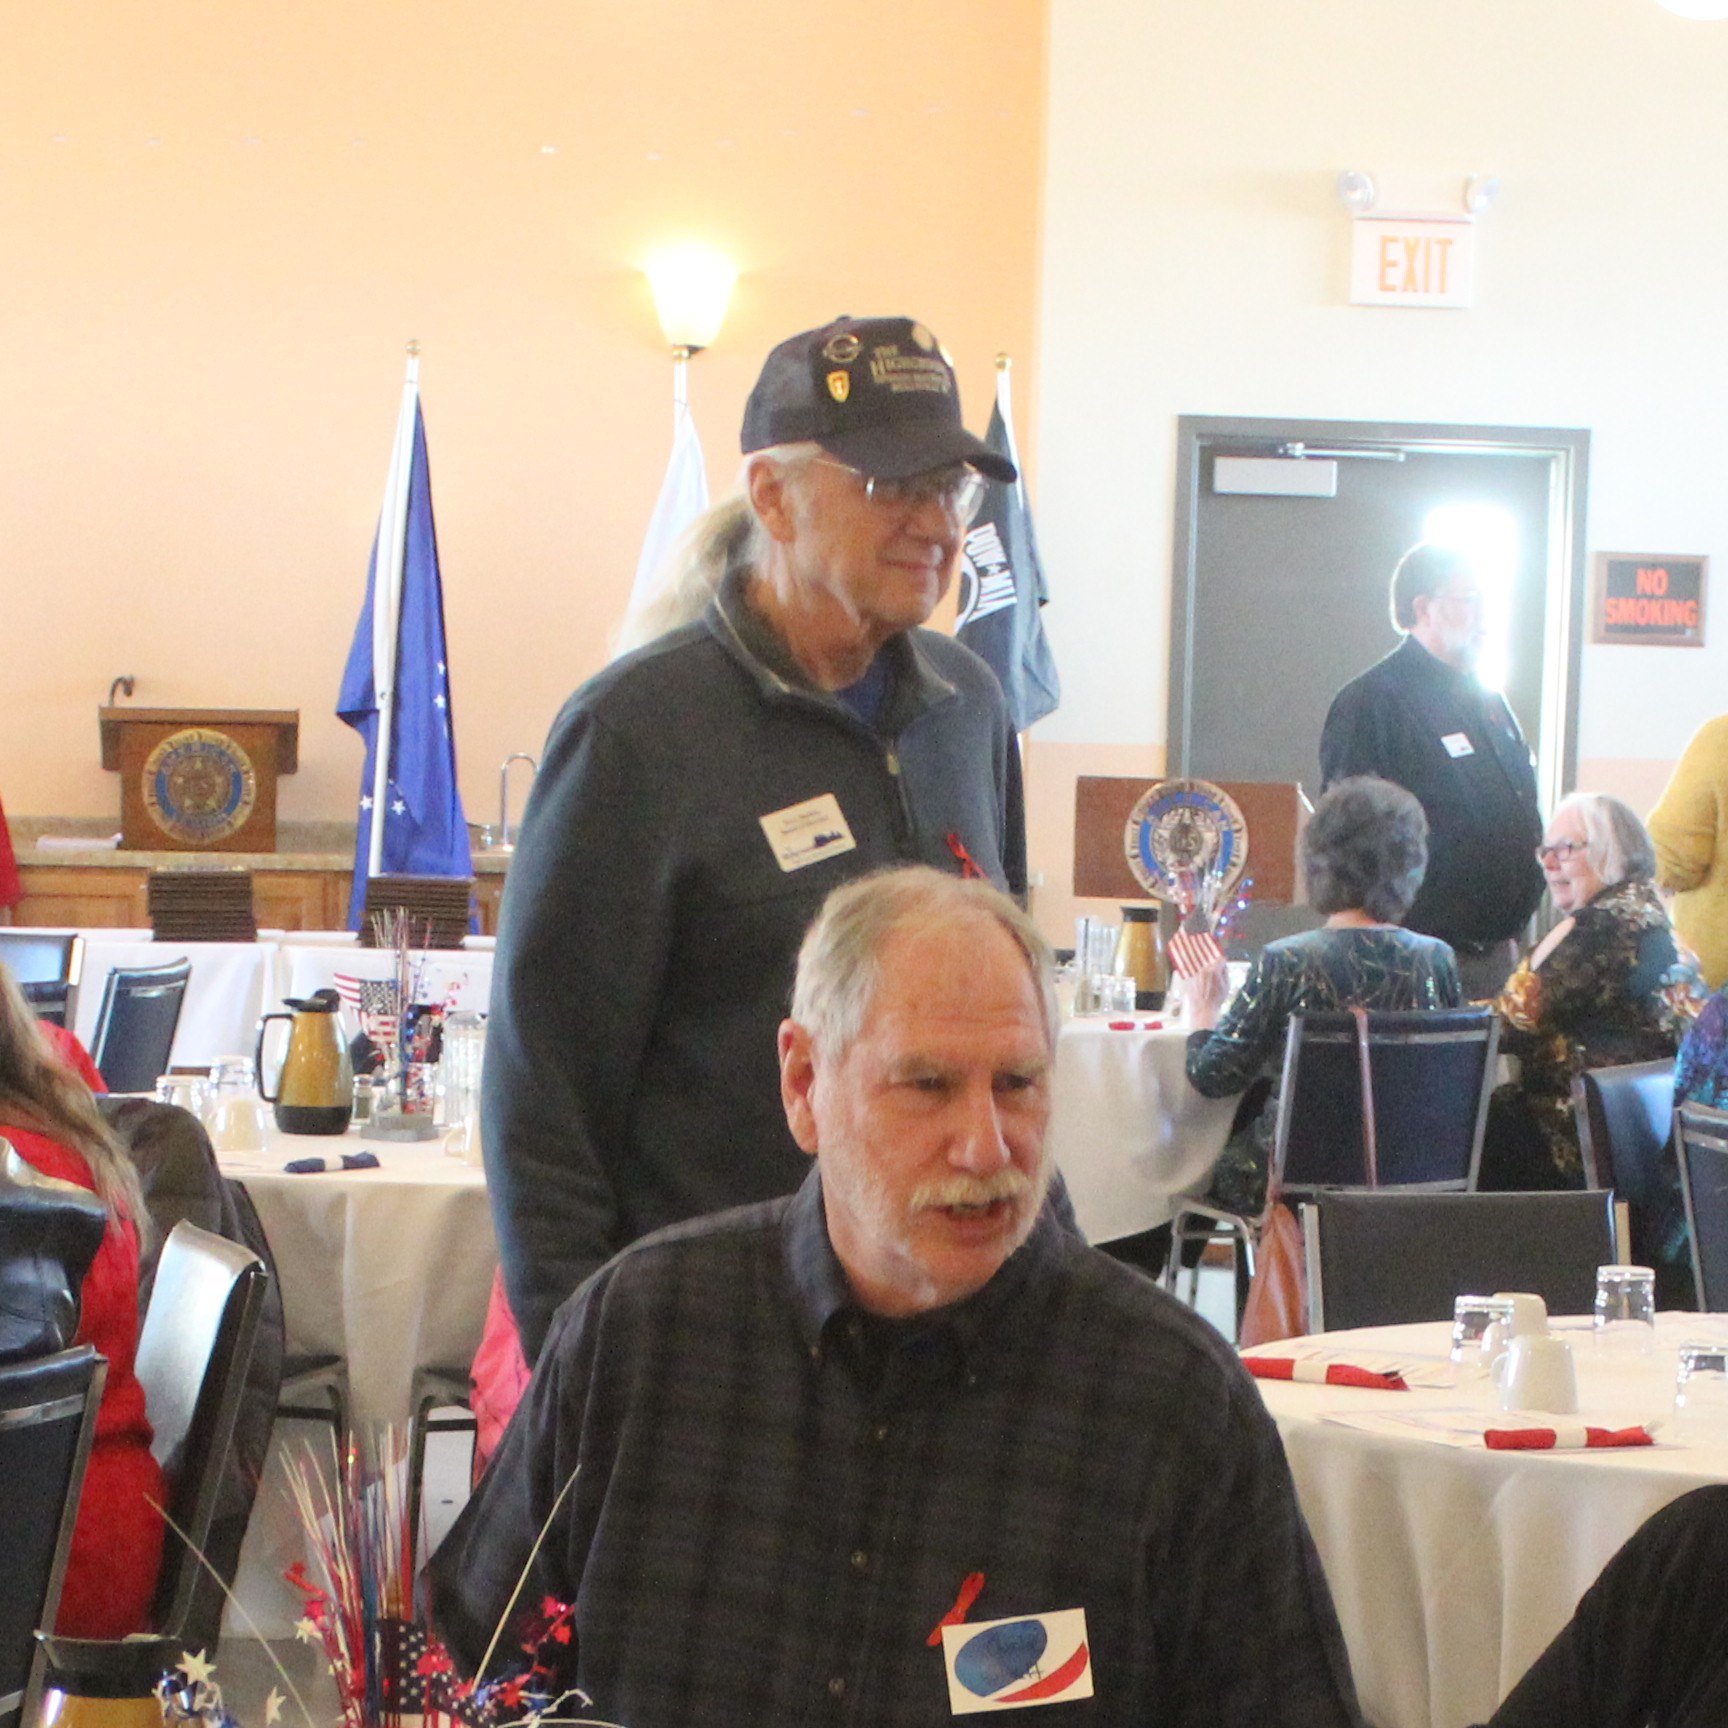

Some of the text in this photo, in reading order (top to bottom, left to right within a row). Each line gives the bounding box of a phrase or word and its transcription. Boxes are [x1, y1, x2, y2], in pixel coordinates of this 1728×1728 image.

[1378, 235, 1454, 294] EXIT
[1636, 568, 1669, 596] NO
[1605, 597, 1699, 627] SMOKING
